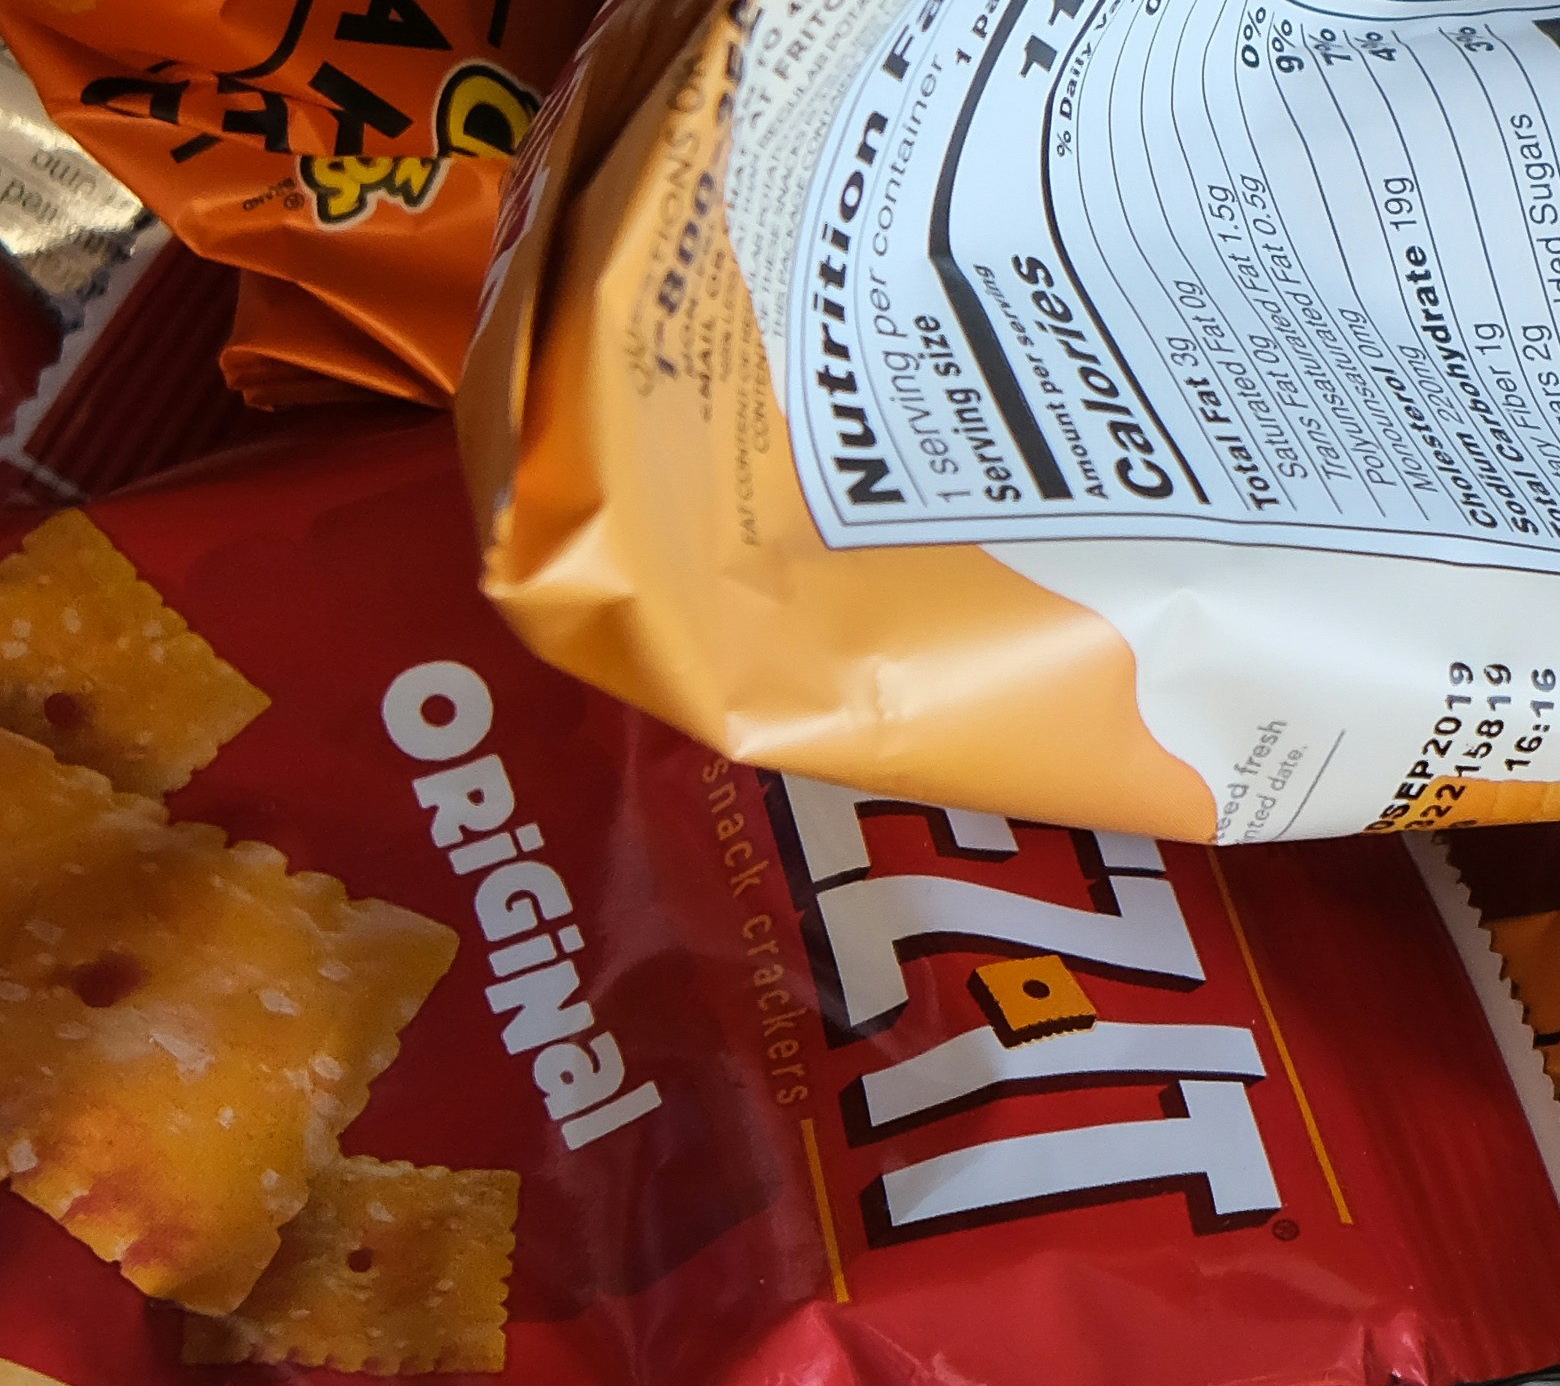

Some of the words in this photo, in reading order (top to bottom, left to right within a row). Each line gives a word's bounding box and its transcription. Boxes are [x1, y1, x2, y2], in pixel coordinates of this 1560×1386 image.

[832, 109, 906, 507] Nutrition
[927, 314, 960, 377] size
[1012, 252, 1174, 502] Calories
[960, 382, 1021, 503] Serving
[1505, 668, 1557, 771] 16:16
[701, 756, 768, 892] snack
[737, 911, 810, 1108] crackers
